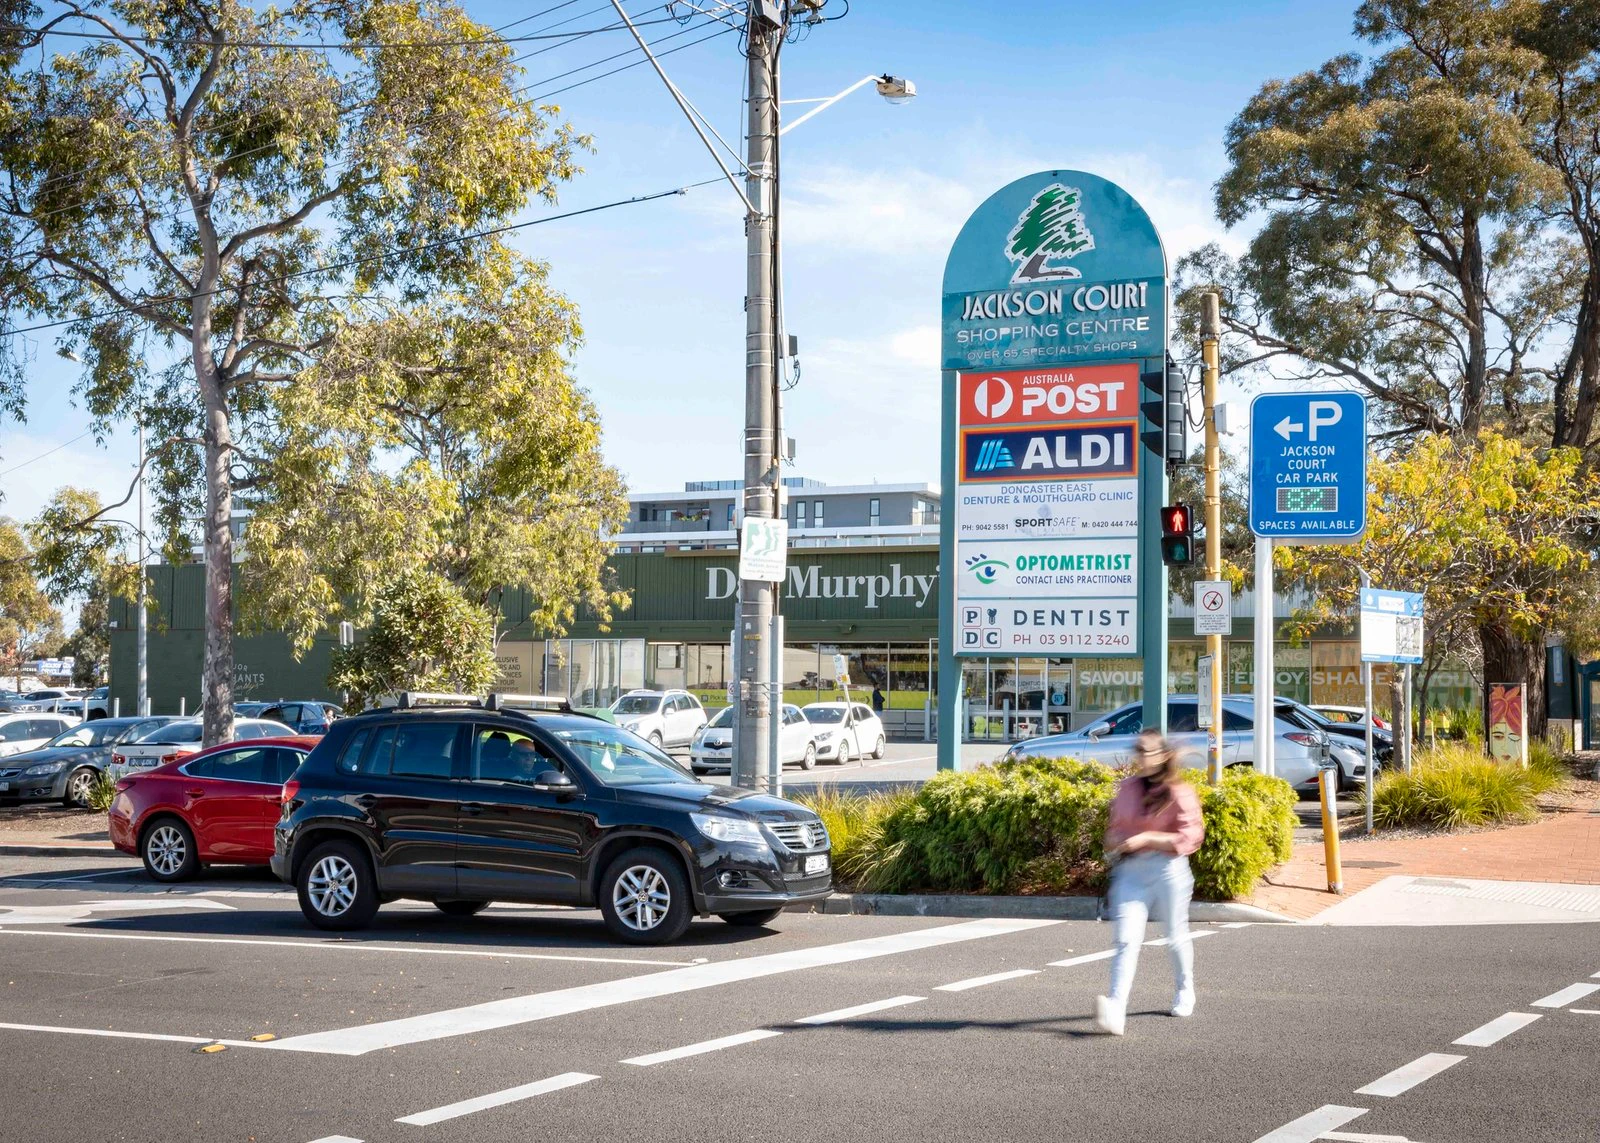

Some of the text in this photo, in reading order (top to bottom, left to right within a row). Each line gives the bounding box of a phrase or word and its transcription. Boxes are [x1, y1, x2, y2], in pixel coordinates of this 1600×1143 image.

[961, 281, 1149, 320] JACKSON COURT
[957, 316, 1150, 343] SHOPPING CENTRE
[967, 340, 1137, 361] OVER 65 SPECIALTY SHOPS
[1023, 373, 1074, 385] AUSTRALIA
[1022, 381, 1125, 416] POST
[1308, 400, 1343, 442] P
[1020, 433, 1125, 470] ALDI
[1280, 445, 1335, 457] JACKSON
[1288, 458, 1327, 470] COURT
[1276, 472, 1339, 484] CAR PARK
[1001, 483, 1093, 495] DONCASTER EAST
[963, 491, 1133, 505] DENTURE & MOUTHGUARD CLINIC
[1287, 488, 1324, 511] 82
[975, 523, 992, 531] 9042
[993, 523, 1009, 531] 5581
[1110, 520, 1123, 528] 444
[1259, 519, 1355, 530] SPACES AVAILABLE
[1016, 554, 1132, 571] OPTOMETRIST
[1016, 574, 1132, 585] CONTACT LENS PRACTITIONER
[966, 609, 1130, 626] P DENTIST
[1013, 634, 1031, 645] PH
[1039, 634, 1055, 646] 03
[1060, 634, 1092, 646] 9112
[1096, 634, 1130, 646] 3240
[1080, 663, 1124, 671] SPIRITS
